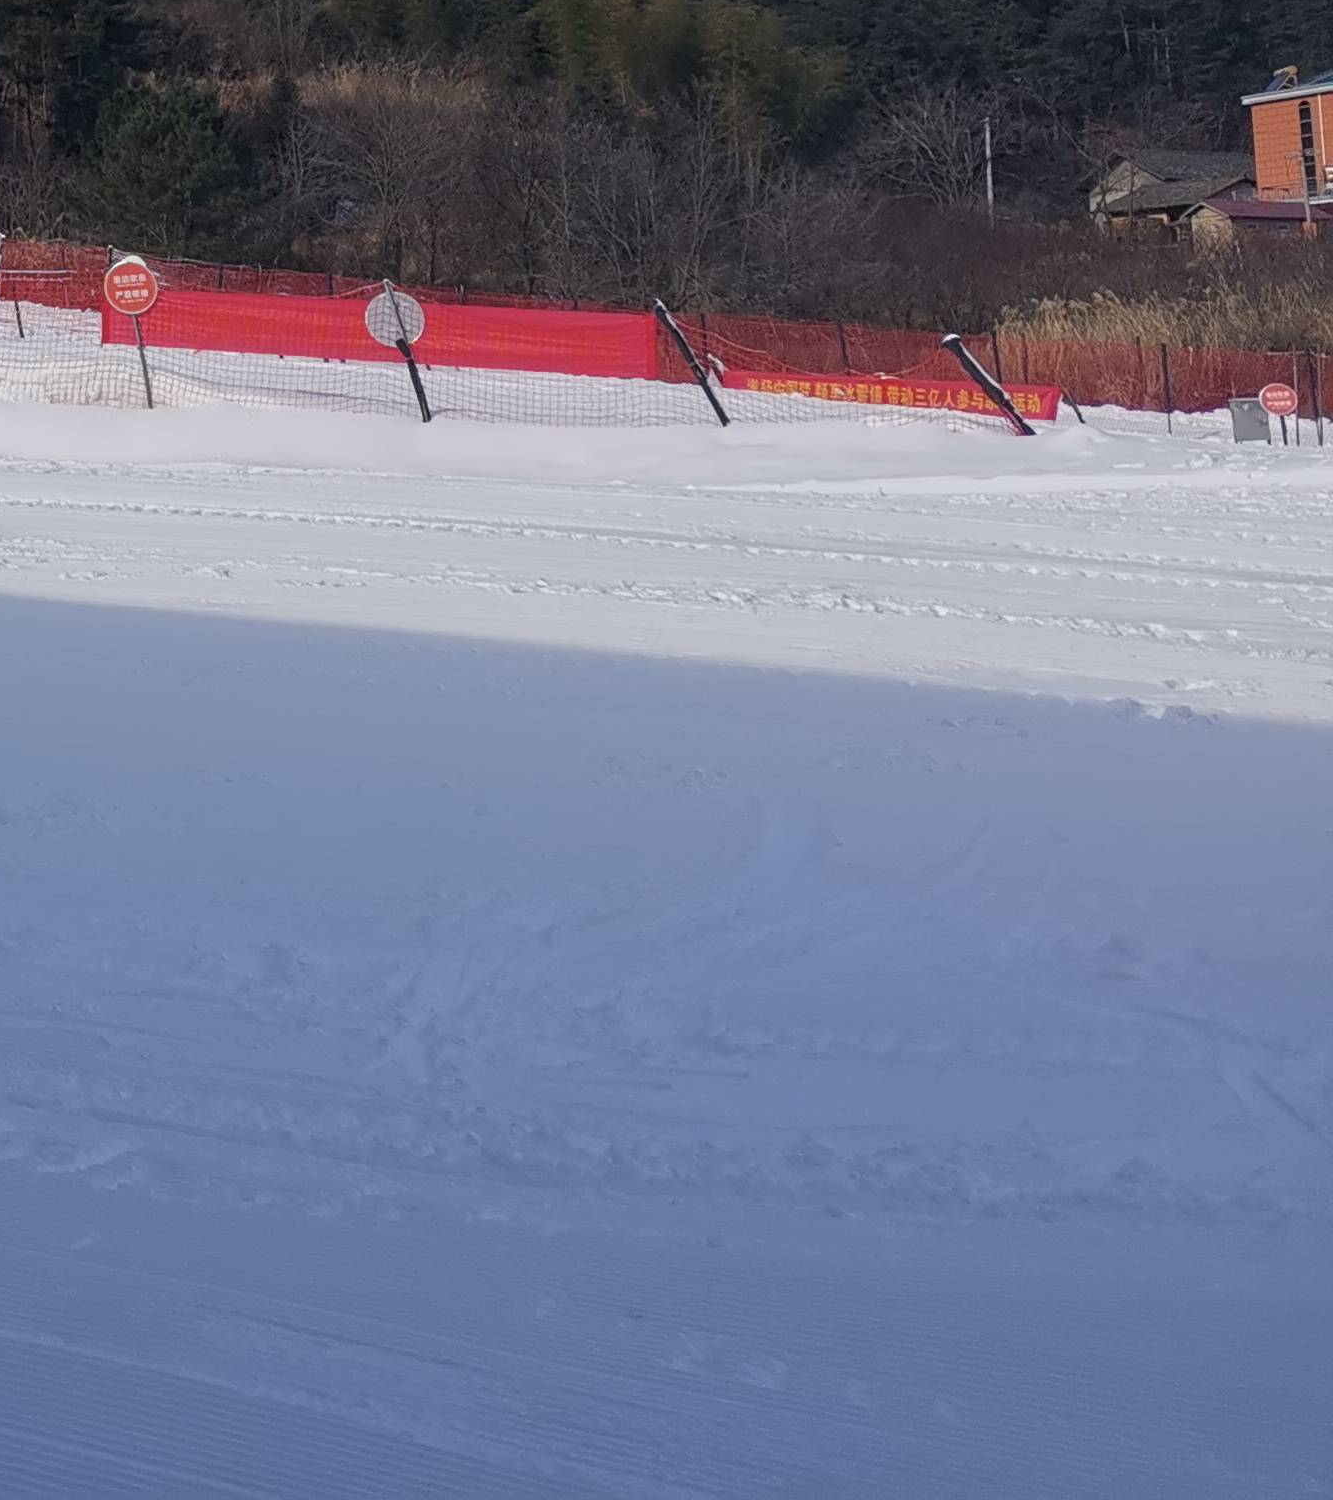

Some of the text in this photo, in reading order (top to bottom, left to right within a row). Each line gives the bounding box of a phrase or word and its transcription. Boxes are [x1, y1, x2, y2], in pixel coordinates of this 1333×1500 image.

[887, 384, 1041, 415] 带动三亿人参与运动
